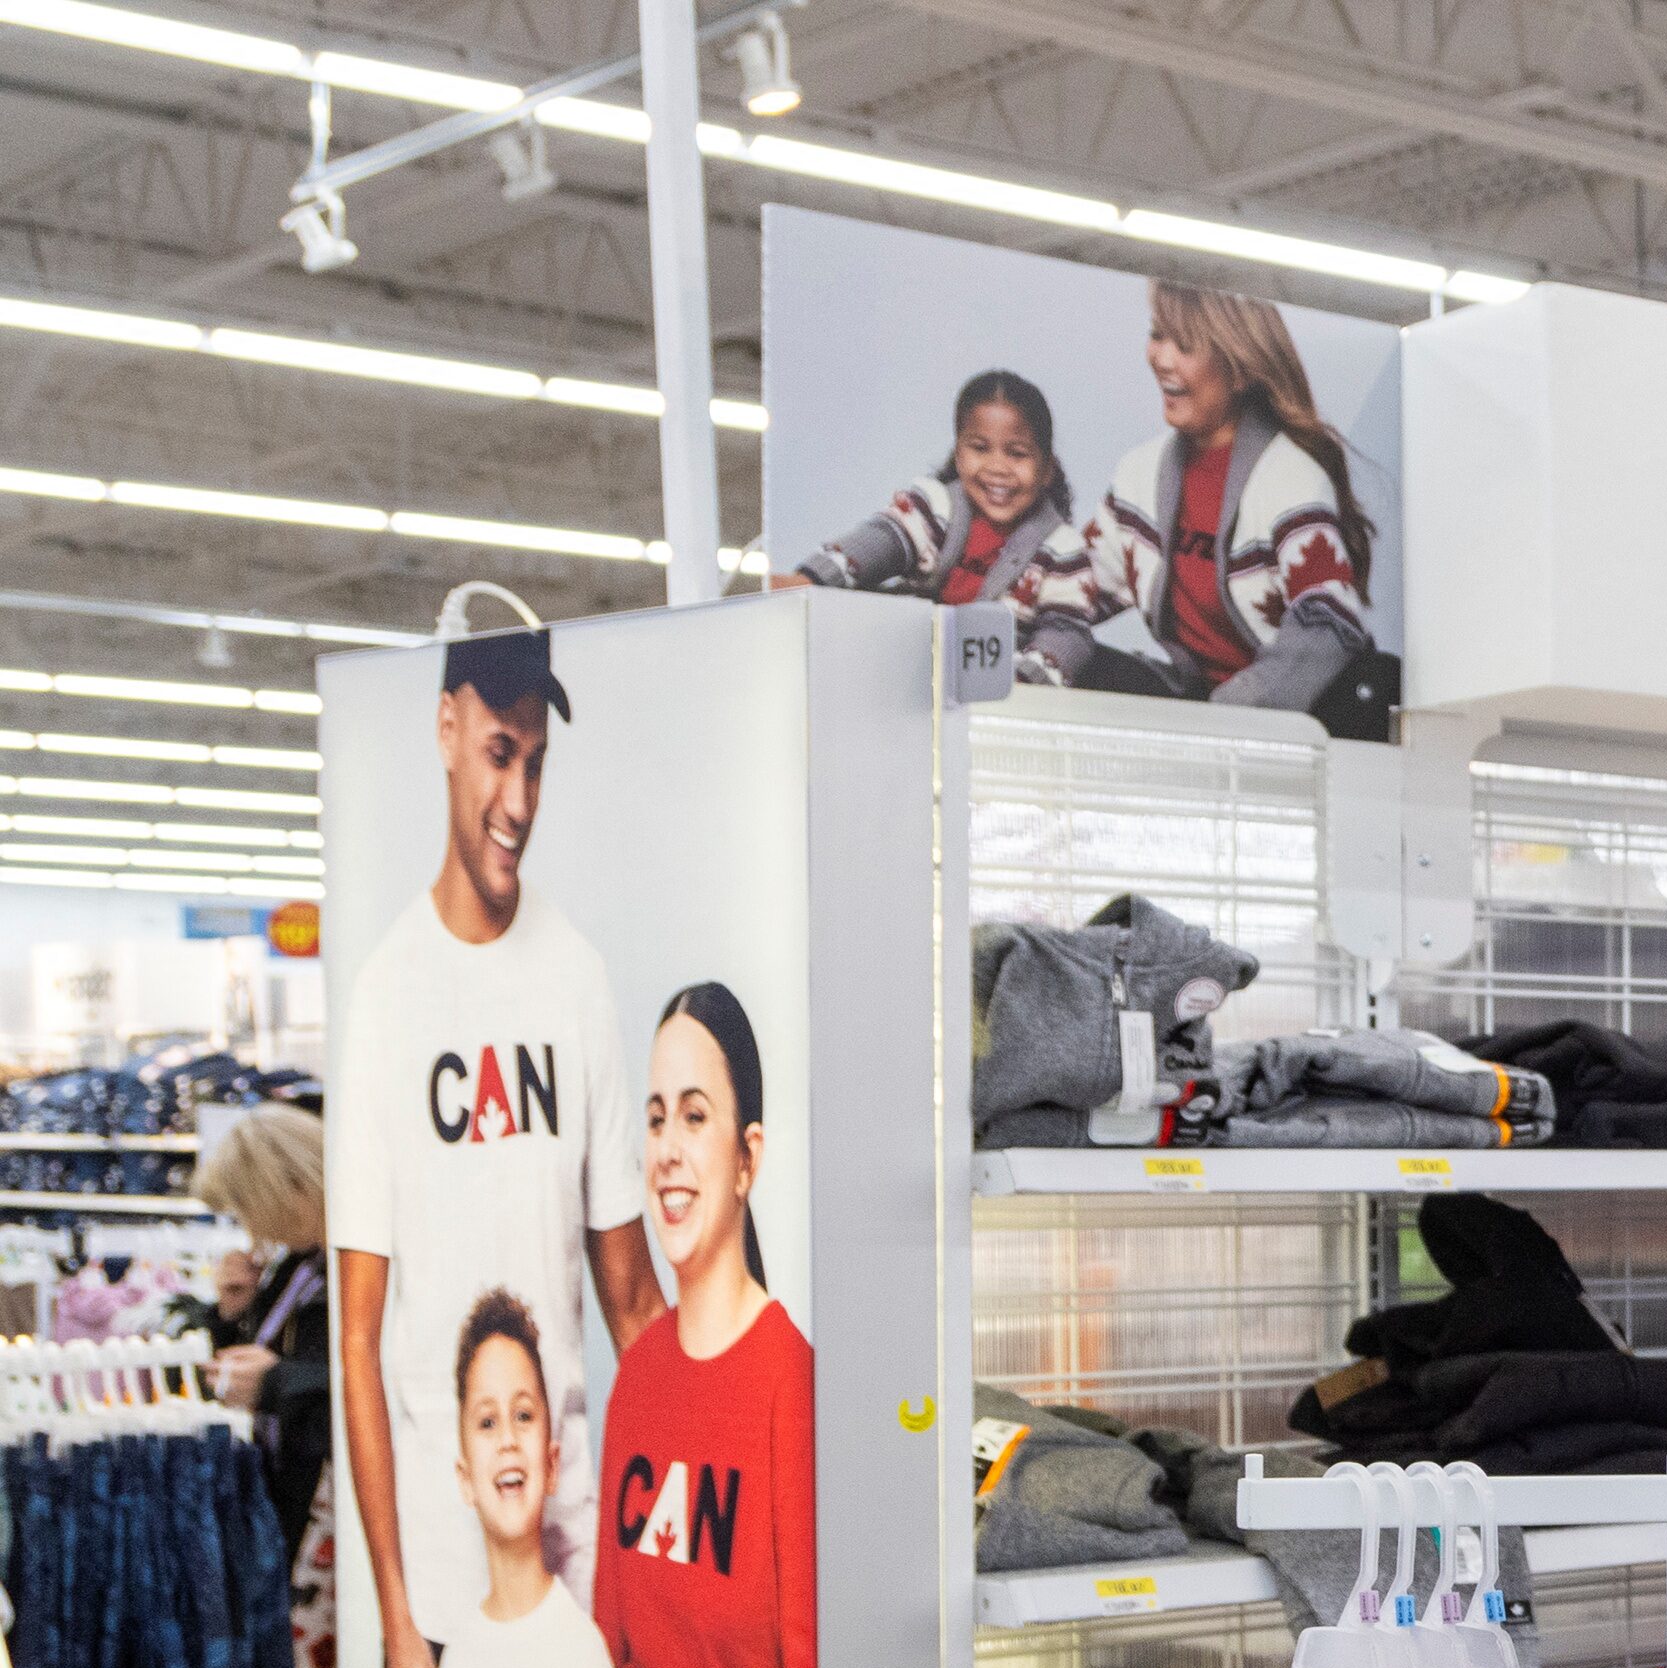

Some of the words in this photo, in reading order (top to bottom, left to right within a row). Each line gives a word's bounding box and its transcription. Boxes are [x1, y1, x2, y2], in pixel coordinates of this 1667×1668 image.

[962, 636, 1000, 671] F19
[429, 1041, 561, 1145] CAN
[616, 1452, 741, 1577] CAN
